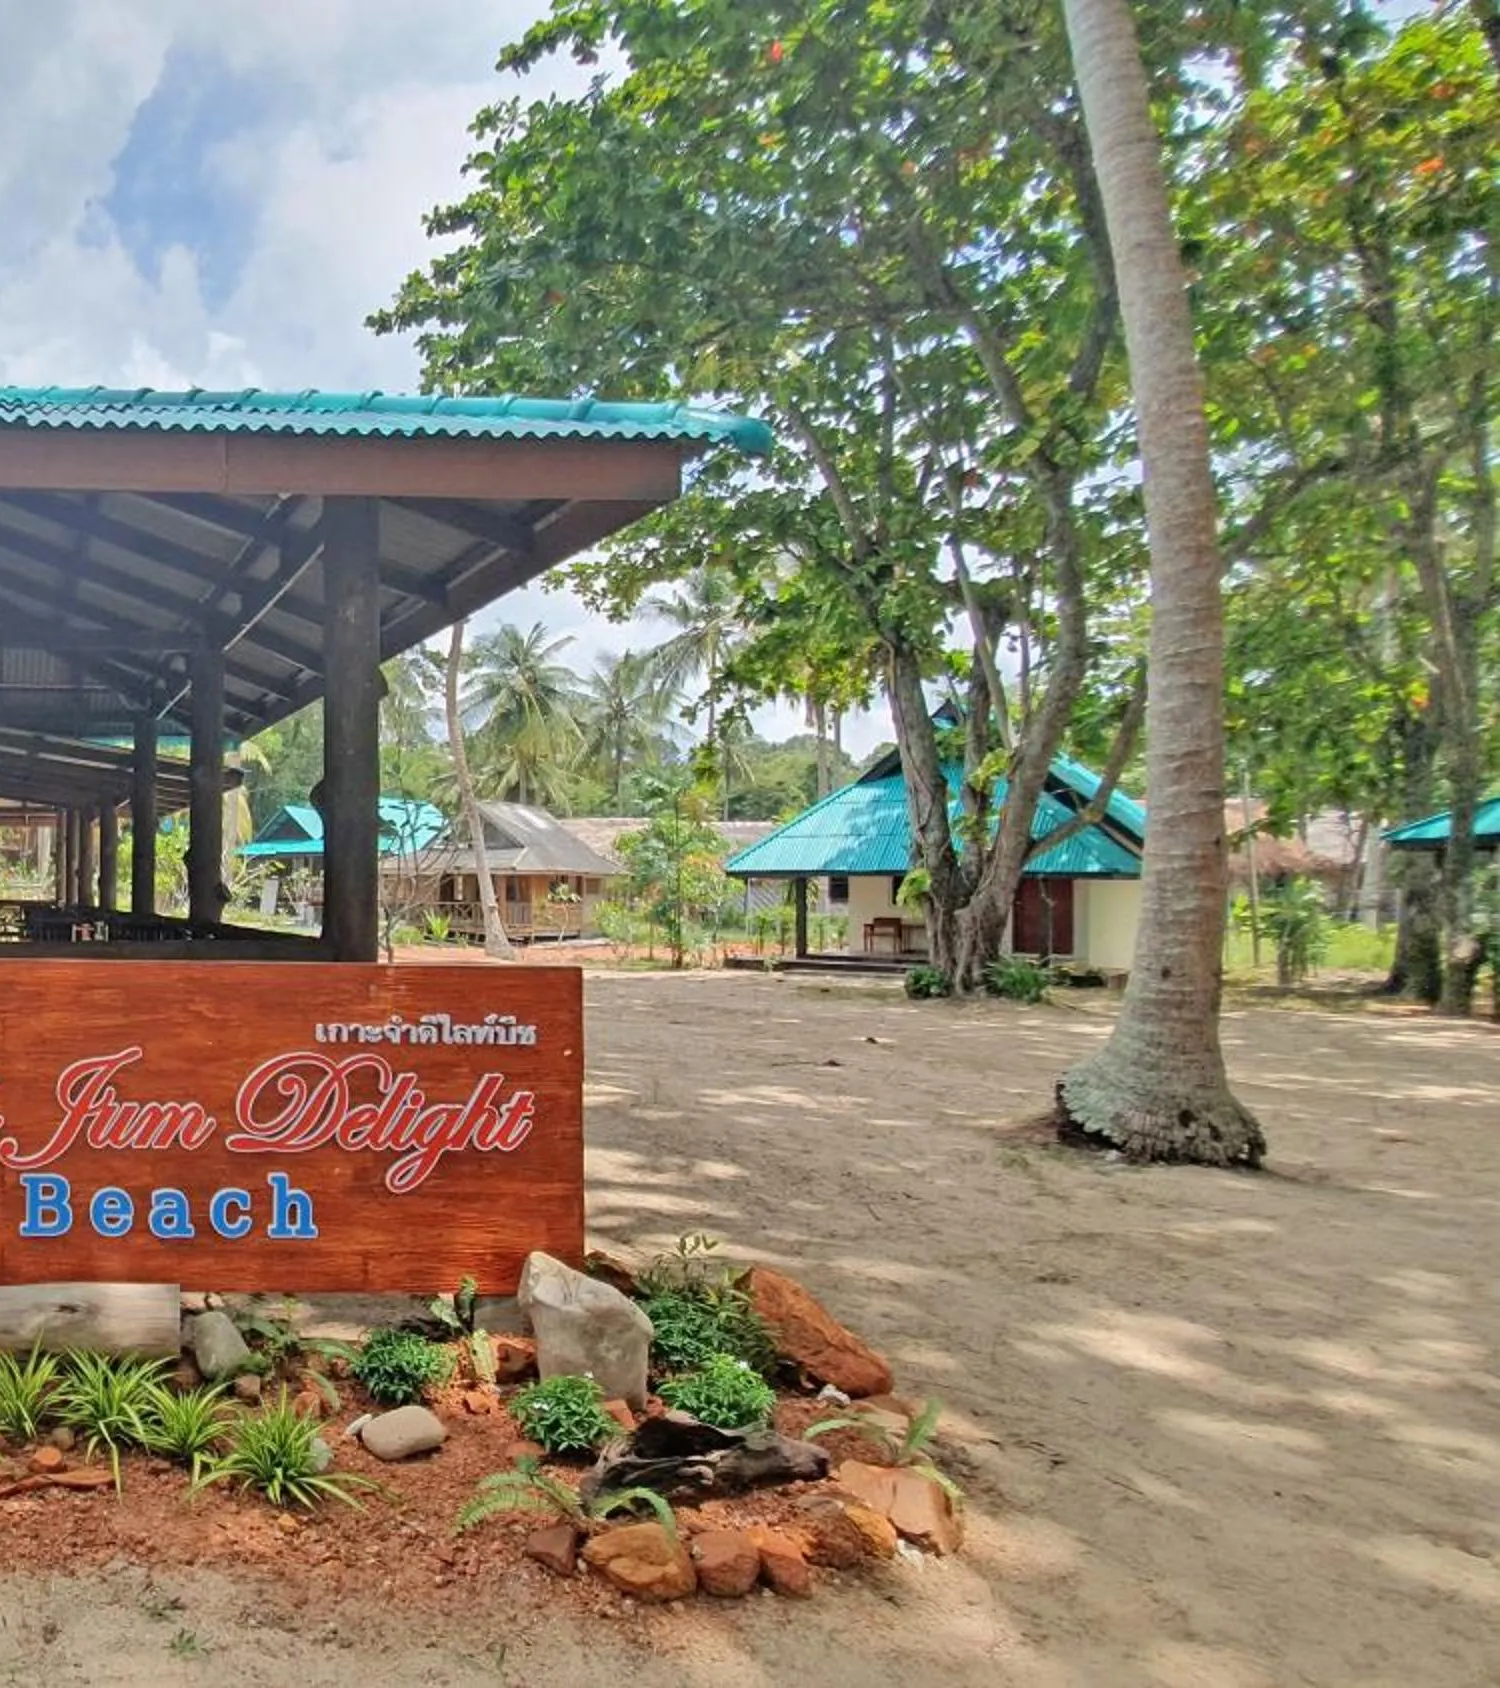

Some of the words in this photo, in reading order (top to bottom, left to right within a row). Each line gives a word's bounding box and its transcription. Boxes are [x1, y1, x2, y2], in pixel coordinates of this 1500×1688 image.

[315, 1013, 537, 1045] เกาะจำดีไลท์บีช
[225, 1051, 535, 1193] Delight
[19, 1172, 319, 1239] Beach
